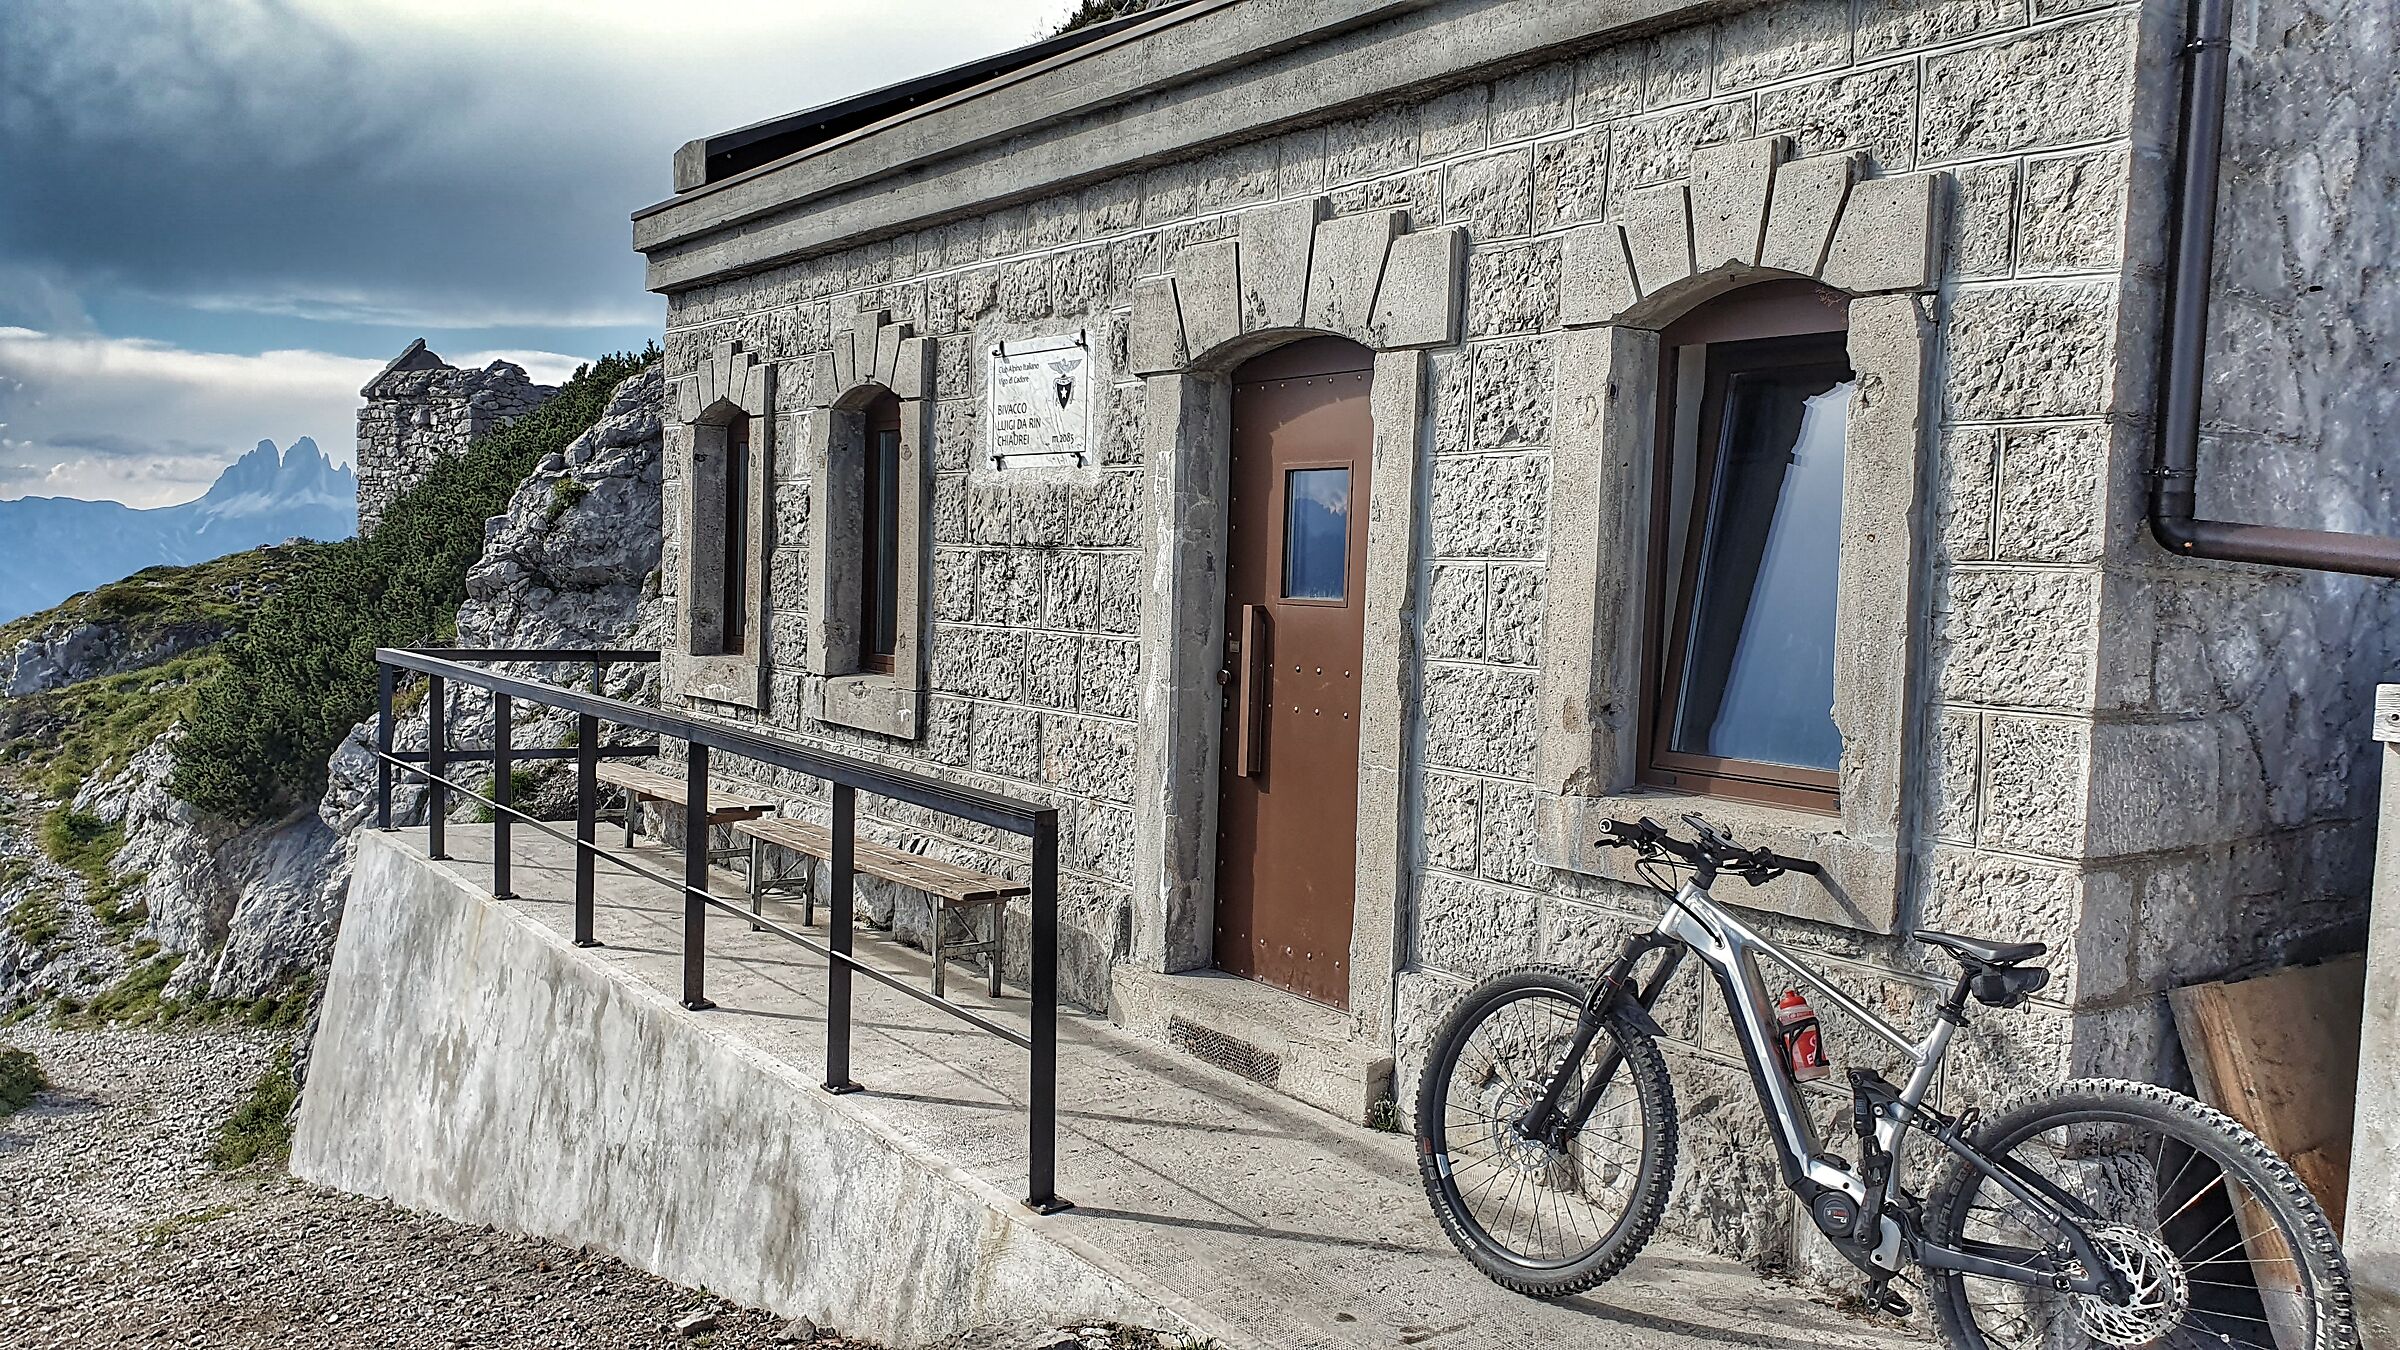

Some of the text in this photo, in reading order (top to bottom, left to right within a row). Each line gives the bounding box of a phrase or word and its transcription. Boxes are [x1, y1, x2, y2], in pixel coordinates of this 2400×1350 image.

[999, 362, 1040, 374] Club Alpino Italiano
[1014, 375, 1030, 384] Cadore
[998, 402, 1027, 415] BIVACCO
[998, 418, 1041, 431] LUIGI DA RIN
[998, 434, 1030, 447] CHIADREI
[1425, 1154, 1478, 1250] SCHWALBE
